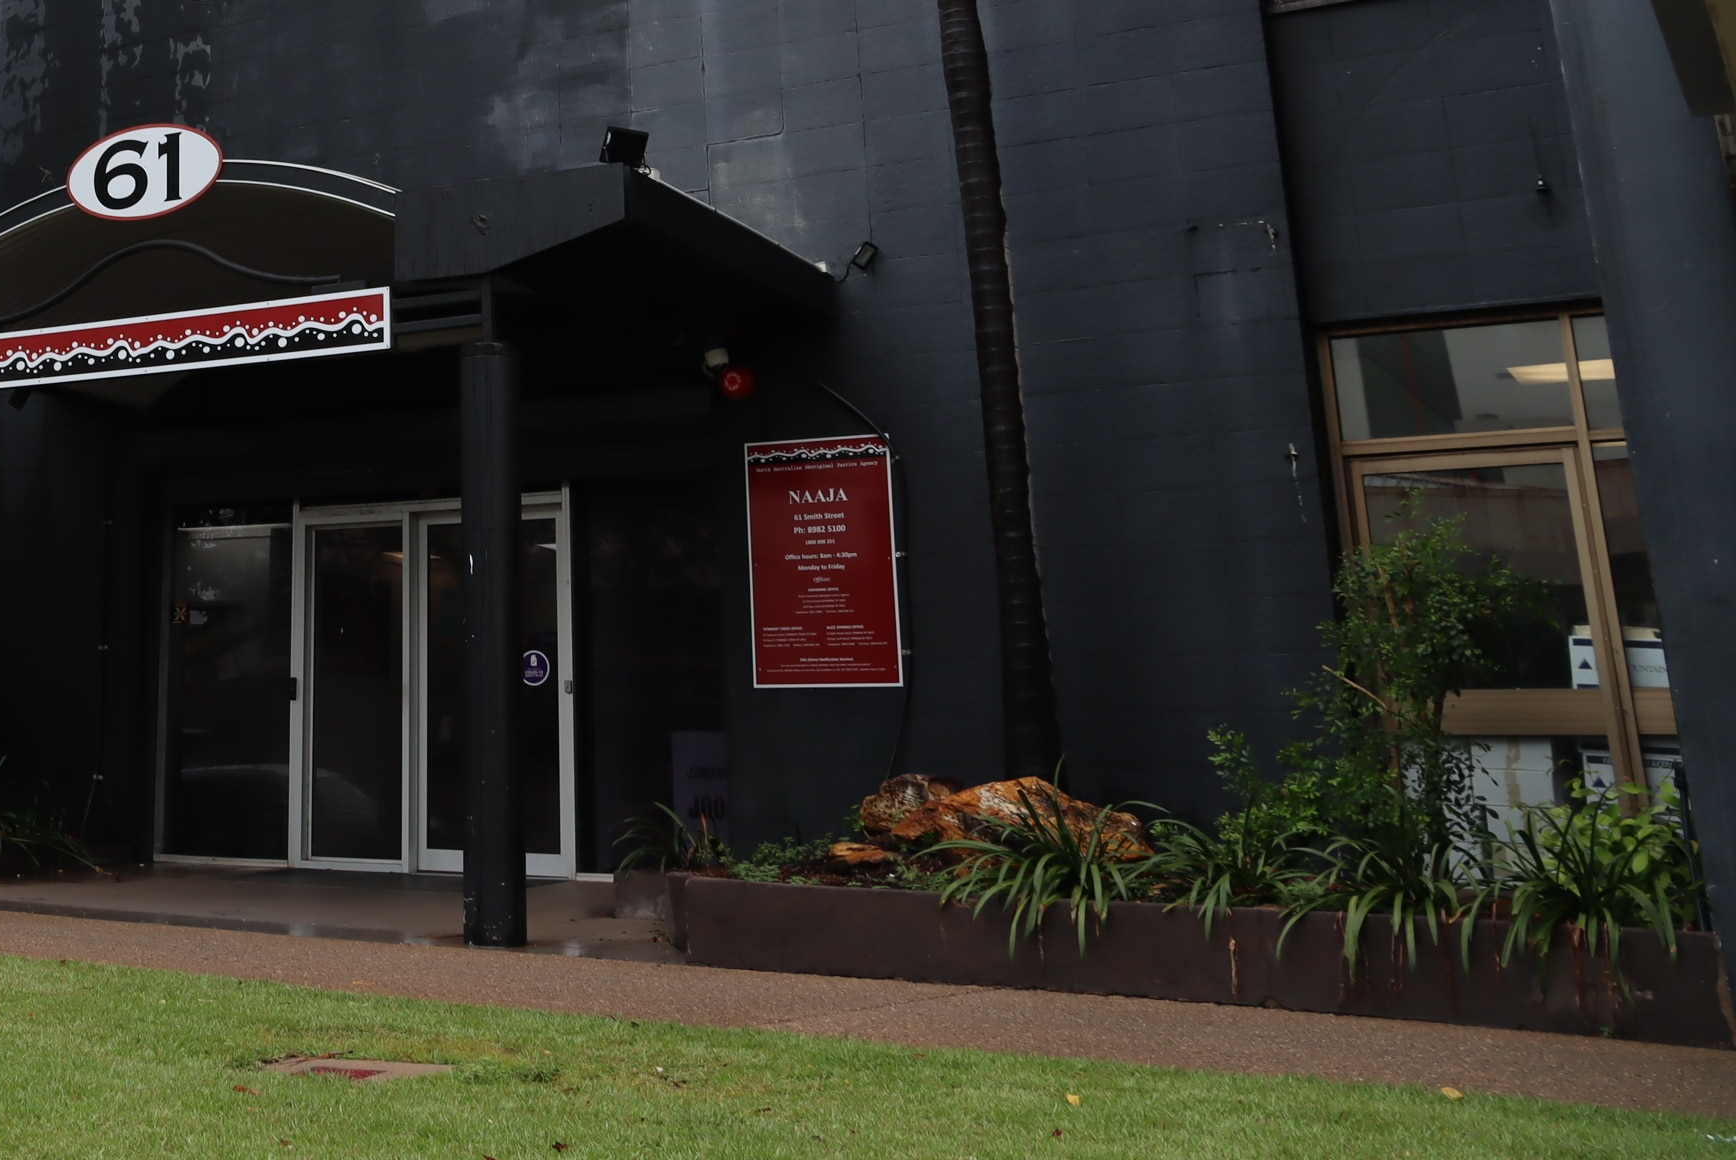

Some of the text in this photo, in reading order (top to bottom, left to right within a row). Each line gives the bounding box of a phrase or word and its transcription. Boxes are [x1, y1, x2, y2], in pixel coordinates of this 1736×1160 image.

[93, 131, 183, 210] 61
[788, 487, 848, 505] NAAJA
[803, 512, 823, 520] Smith
[824, 511, 845, 519] Street
[793, 524, 846, 534] Ph: 8982 5100
[801, 552, 819, 560] hours:
